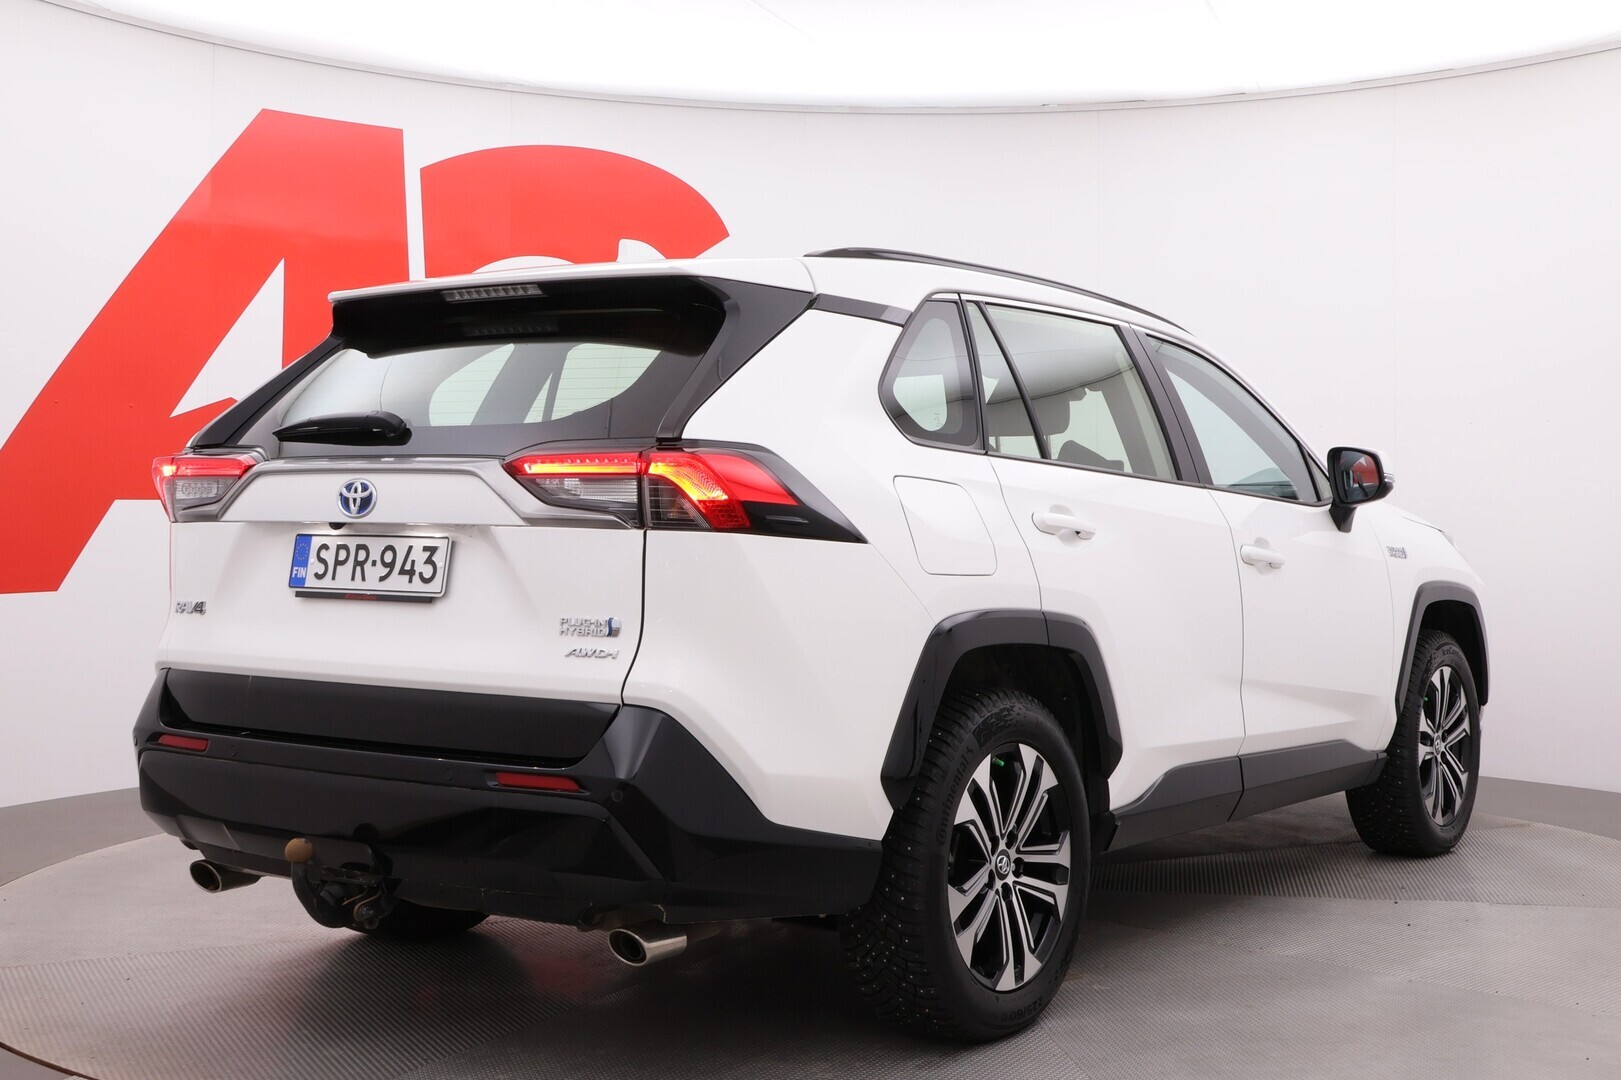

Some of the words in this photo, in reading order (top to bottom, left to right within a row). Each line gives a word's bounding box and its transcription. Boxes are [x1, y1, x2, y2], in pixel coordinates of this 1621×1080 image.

[292, 566, 308, 579] FIN
[560, 618, 608, 629] PLUG-IN
[560, 626, 608, 637] HYBRID
